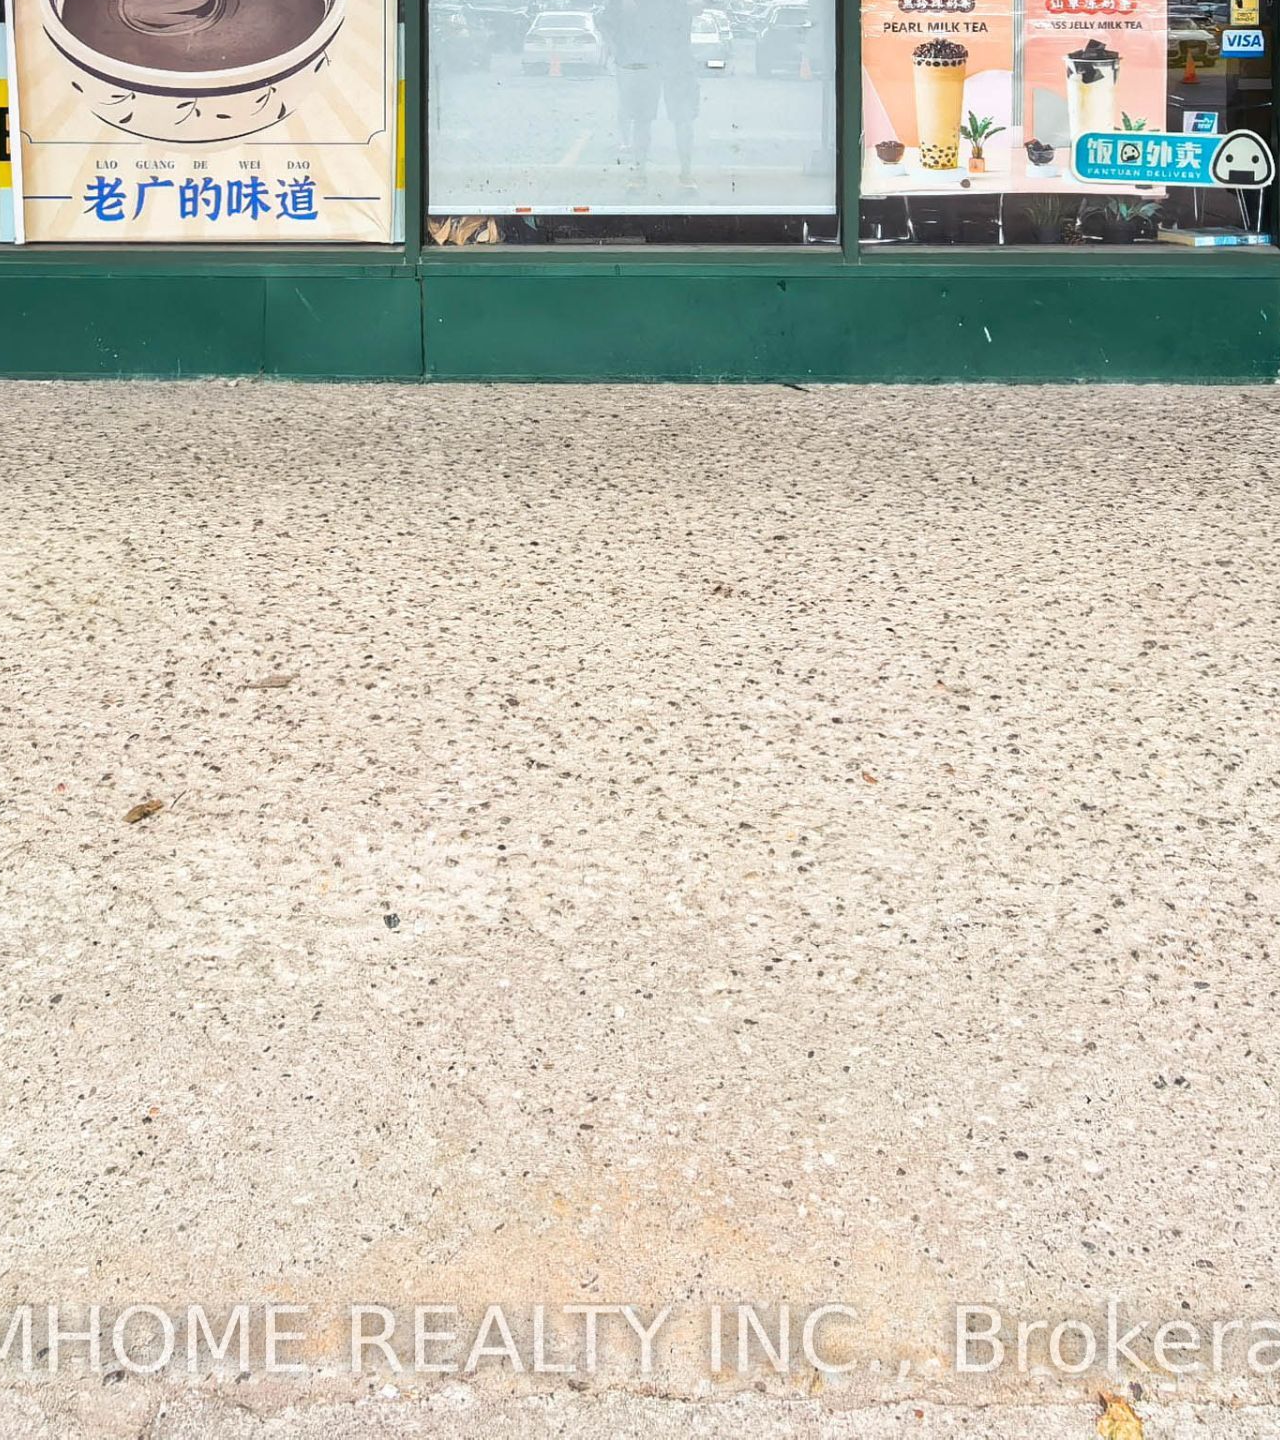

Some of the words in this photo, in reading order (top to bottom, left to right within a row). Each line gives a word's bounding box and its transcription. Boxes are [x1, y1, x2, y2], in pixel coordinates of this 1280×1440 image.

[883, 22, 923, 33] PEARL
[927, 22, 960, 33] MILK
[963, 22, 988, 33] TEA
[1069, 21, 1095, 30] JELLY
[1098, 21, 1121, 30] MILK
[1125, 21, 1142, 30] TEA
[1227, 35, 1261, 47] VISA
[96, 160, 118, 170] LAO
[135, 160, 175, 170] GUANG
[193, 160, 208, 170] DE
[238, 160, 261, 170] WEI
[287, 160, 311, 170] DAO
[1087, 168, 1141, 178] FANTUAN
[1146, 171, 1202, 180] DELIVERY
[83, 175, 320, 222] 老广的味道
